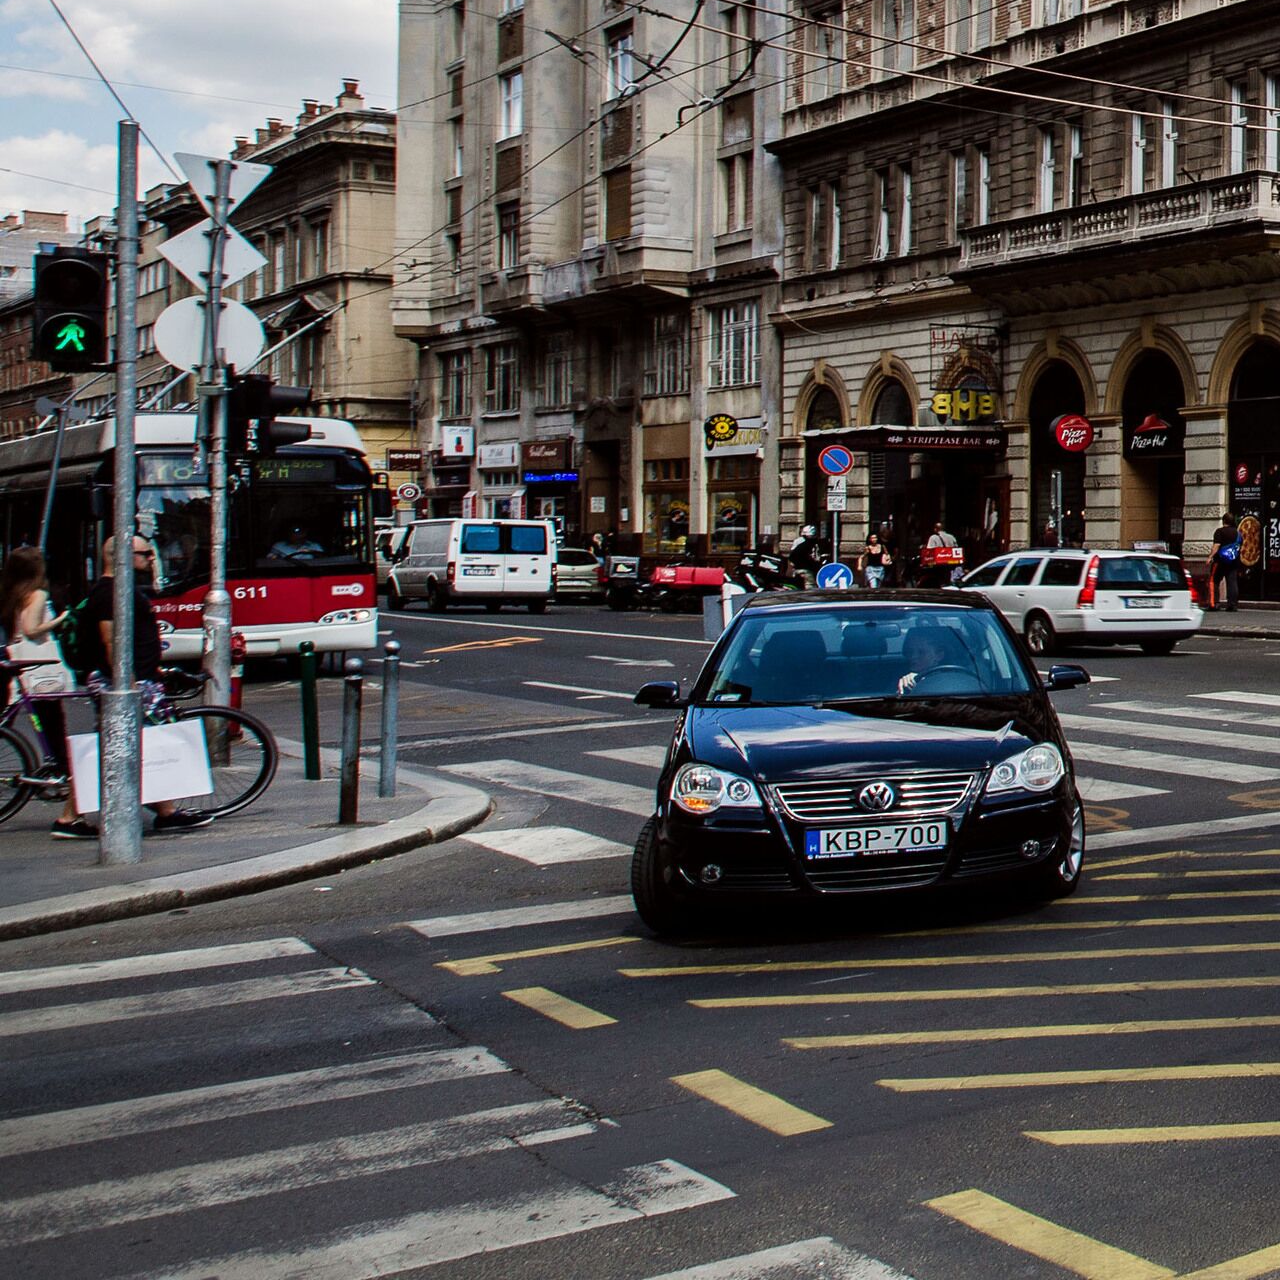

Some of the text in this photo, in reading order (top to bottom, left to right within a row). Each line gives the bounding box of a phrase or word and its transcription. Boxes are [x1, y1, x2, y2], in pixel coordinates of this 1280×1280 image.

[1061, 428, 1087, 440] Pizza
[907, 436, 961, 445] STRIPTEASE
[1066, 436, 1086, 447] Hut
[1130, 434, 1168, 450] Pizza Hut
[233, 586, 268, 599] 611
[826, 825, 940, 852] KBP-700
[809, 844, 817, 852] H
